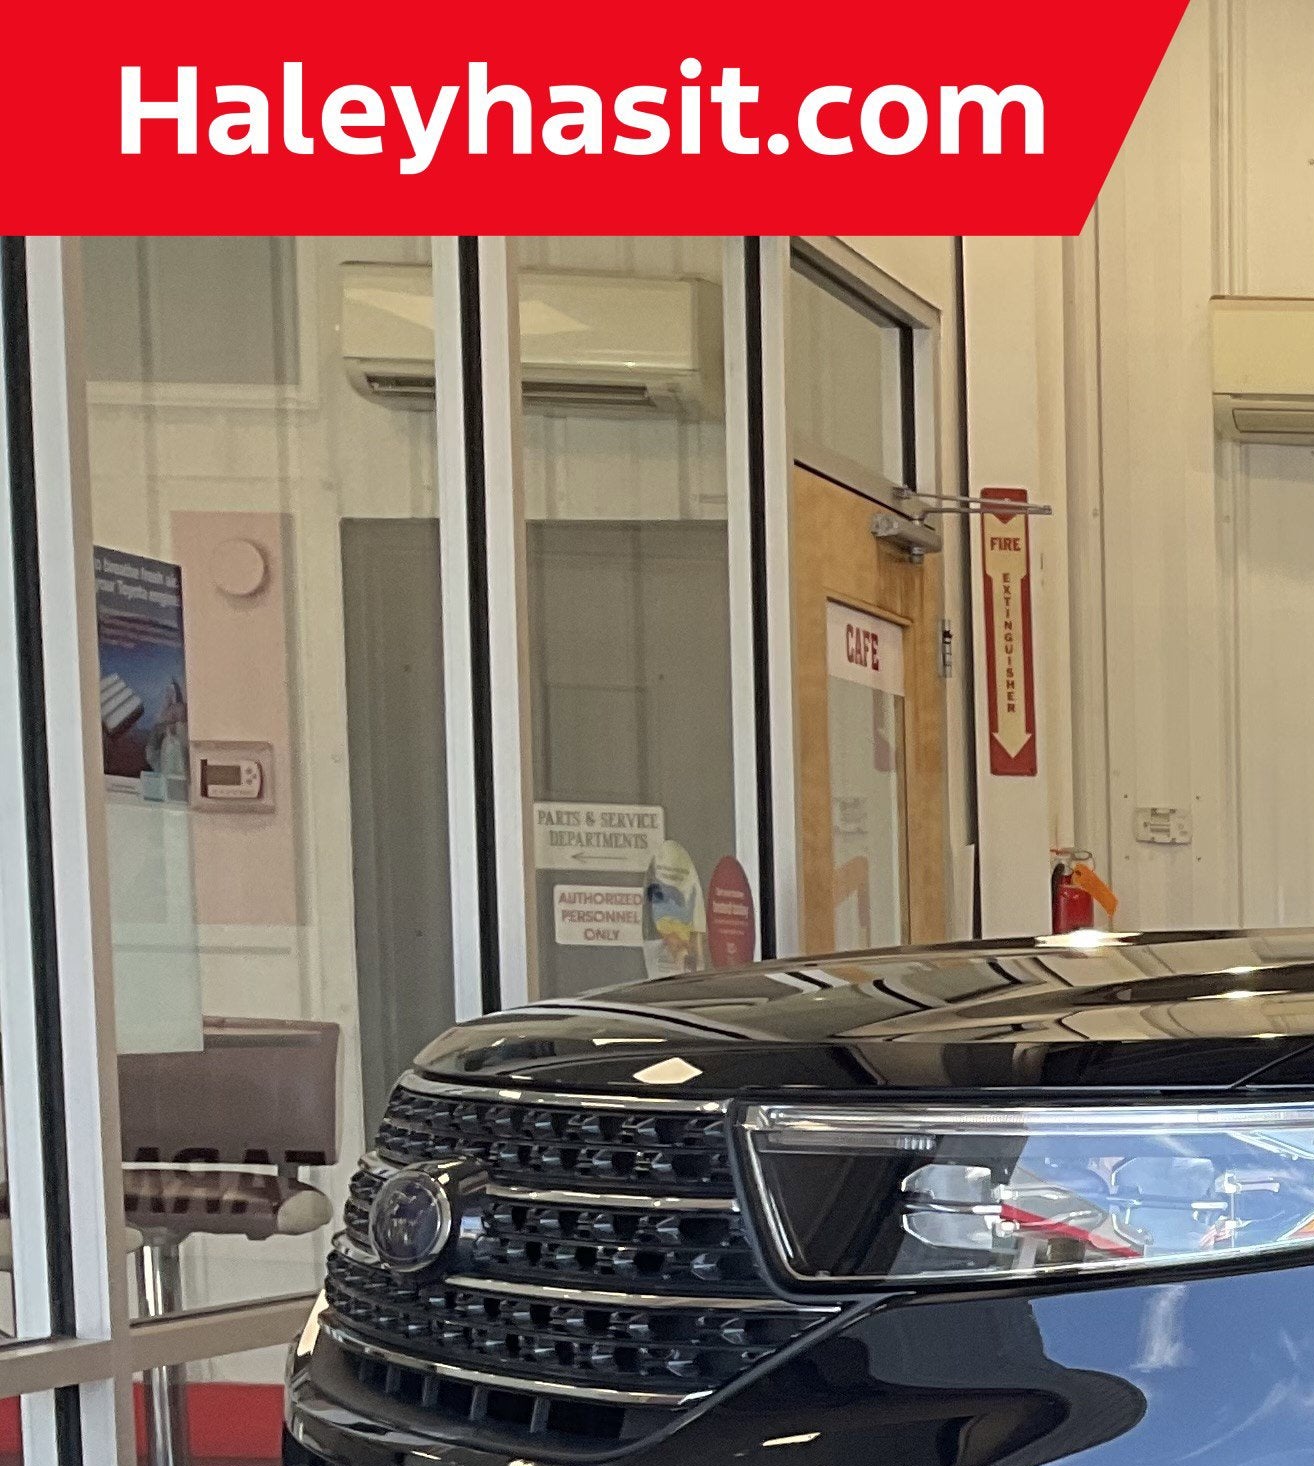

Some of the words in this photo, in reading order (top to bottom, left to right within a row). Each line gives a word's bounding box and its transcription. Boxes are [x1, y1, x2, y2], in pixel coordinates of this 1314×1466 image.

[990, 537, 1022, 551] FIRE
[845, 623, 880, 671] CAFE
[1002, 572, 1016, 713] EXTINGUISHER
[537, 809, 581, 826] PARTS
[584, 811, 596, 824] &
[600, 812, 659, 829] SERVICE
[549, 830, 649, 849] DEPARTMENTS
[557, 892, 643, 906] AUTHORIZED
[561, 909, 641, 924] PERSONNEL
[583, 928, 620, 941] ONLY
